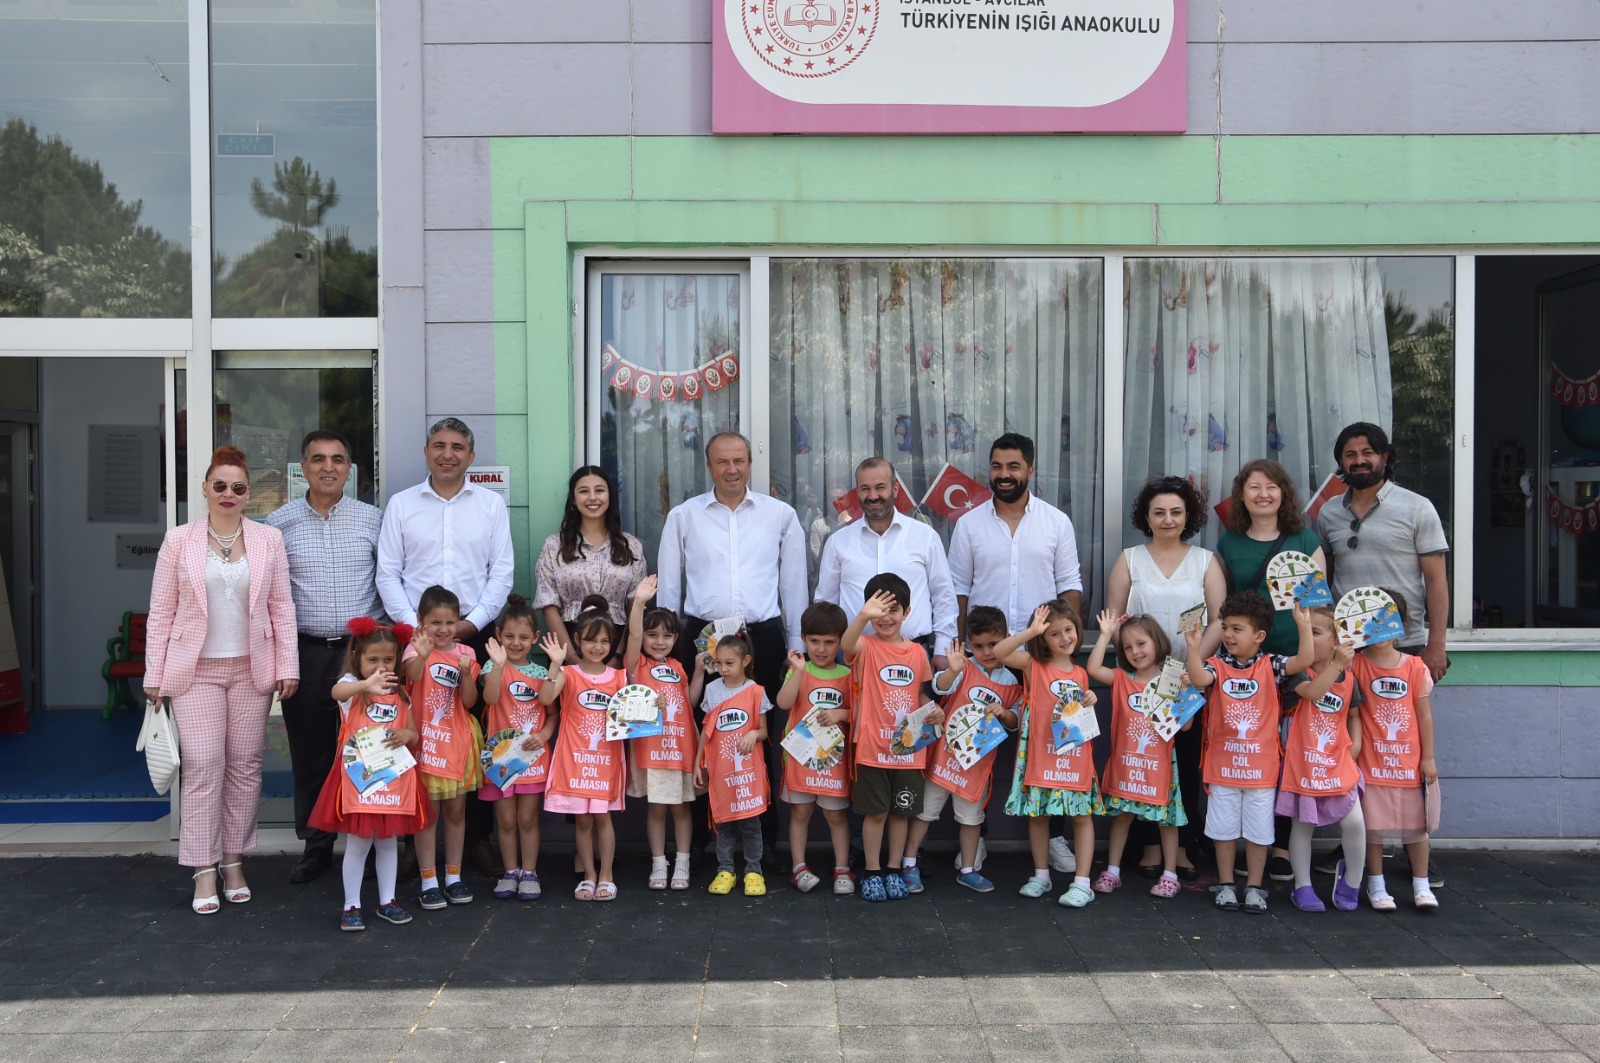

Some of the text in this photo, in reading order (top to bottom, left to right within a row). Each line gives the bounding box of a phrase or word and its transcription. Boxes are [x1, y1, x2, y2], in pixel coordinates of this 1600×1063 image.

[900, 9, 1160, 33] TÜRKİYENİN IŞIĞI ANAOKULU
[821, 7, 854, 50] BAKANLIĞI
[770, 21, 800, 51] TÜRKİYE
[470, 474, 503, 483] KURAL
[437, 665, 457, 683] TEMA
[887, 669, 908, 679] TEMA
[1230, 680, 1250, 691] TEMA
[1379, 680, 1400, 691] TEMA
[586, 692, 607, 703] TEMA
[816, 691, 837, 702] TEMA
[719, 712, 740, 725] TEMA
[421, 723, 452, 743] ÜRKİYE
[663, 723, 685, 737] RKİYE
[422, 739, 437, 754] ÇÖL
[661, 736, 678, 750] ÇÖL
[1223, 740, 1261, 753] TÜRKİYE
[1373, 740, 1410, 754] TÜRKİYE
[415, 751, 447, 768] OMASIN
[572, 750, 611, 766] TÜRKİYE
[877, 753, 914, 764] OLMASIN
[1056, 756, 1071, 771] ÇÖL
[1121, 753, 1159, 771] TÜRKİYE
[1232, 753, 1250, 769] ÇÖL
[1383, 755, 1402, 769] ÇÖL
[582, 764, 598, 780] ÇÖL
[933, 765, 968, 788] OLMASIN
[1043, 770, 1080, 783] OLMASIN
[1129, 768, 1146, 783] ÇÖL
[1221, 767, 1261, 780] OLMASIN
[1312, 765, 1327, 779] ÇÖL
[1371, 768, 1415, 780] OLMASIN
[569, 778, 609, 790] OLMASIN
[724, 771, 756, 788] TÜRKİYE
[805, 777, 843, 789] OLMASIN
[1301, 778, 1341, 790] OLMASIN
[735, 786, 752, 801] ÇÖL
[1118, 781, 1157, 797] OLMASIN
[730, 795, 763, 813] OLMASIN
